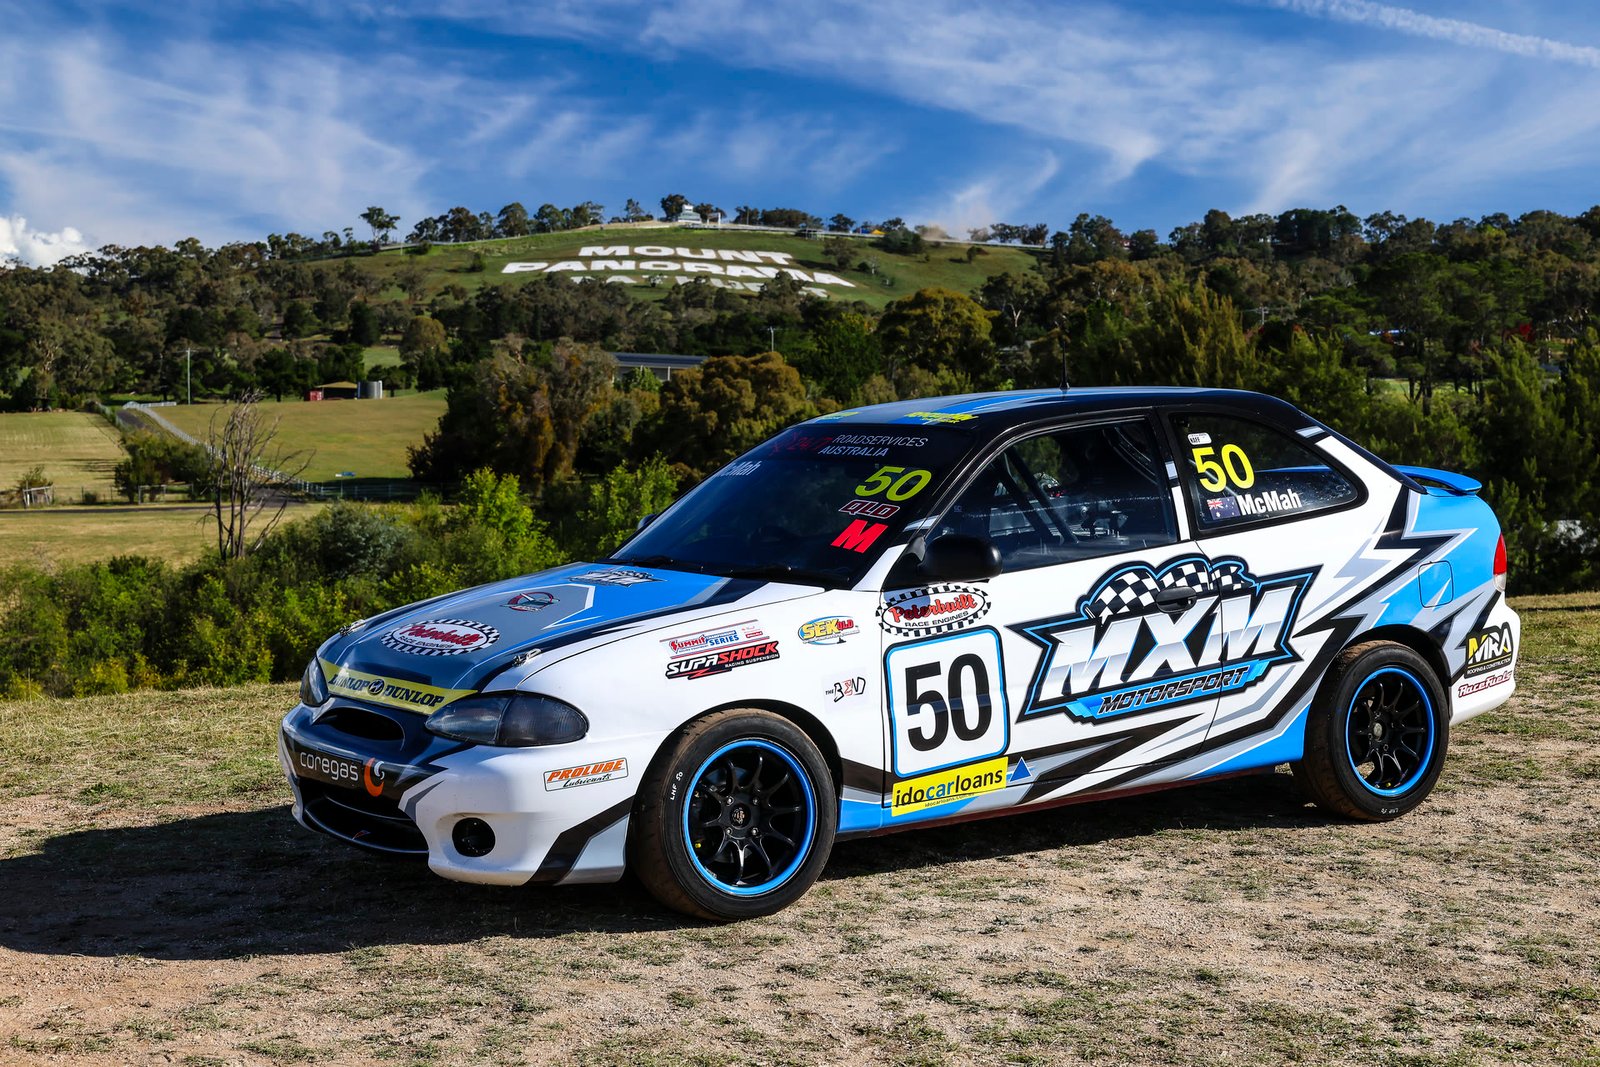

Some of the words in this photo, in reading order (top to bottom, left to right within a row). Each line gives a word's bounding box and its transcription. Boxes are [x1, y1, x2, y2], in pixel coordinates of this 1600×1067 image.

[578, 245, 793, 265] MOUNT
[501, 260, 855, 287] PANORAMA
[818, 445, 889, 457] AUSTRALIA
[832, 434, 929, 447] ROADSERVICES
[1192, 444, 1255, 493] 50
[854, 465, 932, 501] 50
[840, 500, 899, 519] QLD
[1236, 489, 1303, 516] McMah
[830, 519, 888, 553] M
[889, 594, 978, 623] Peterbuilt
[904, 619, 930, 628] RACE
[931, 610, 969, 627] ENGINES
[709, 634, 740, 646] SERIES
[802, 619, 841, 640] SEK
[1038, 585, 1298, 703] MXM
[1468, 628, 1512, 664] MRA
[666, 642, 778, 675] SUPASHOCK
[725, 660, 745, 668] RACING
[745, 653, 779, 664] SUSPENSION
[328, 674, 371, 691] DUNLOP
[382, 684, 444, 707] DUNLOP
[905, 653, 992, 752] 50
[1097, 666, 1249, 714] MOTORSPORT
[300, 752, 359, 781] coregas
[547, 760, 624, 782] PROLUBE
[563, 773, 612, 788] Lubricants
[895, 769, 1003, 808] idocarloans
